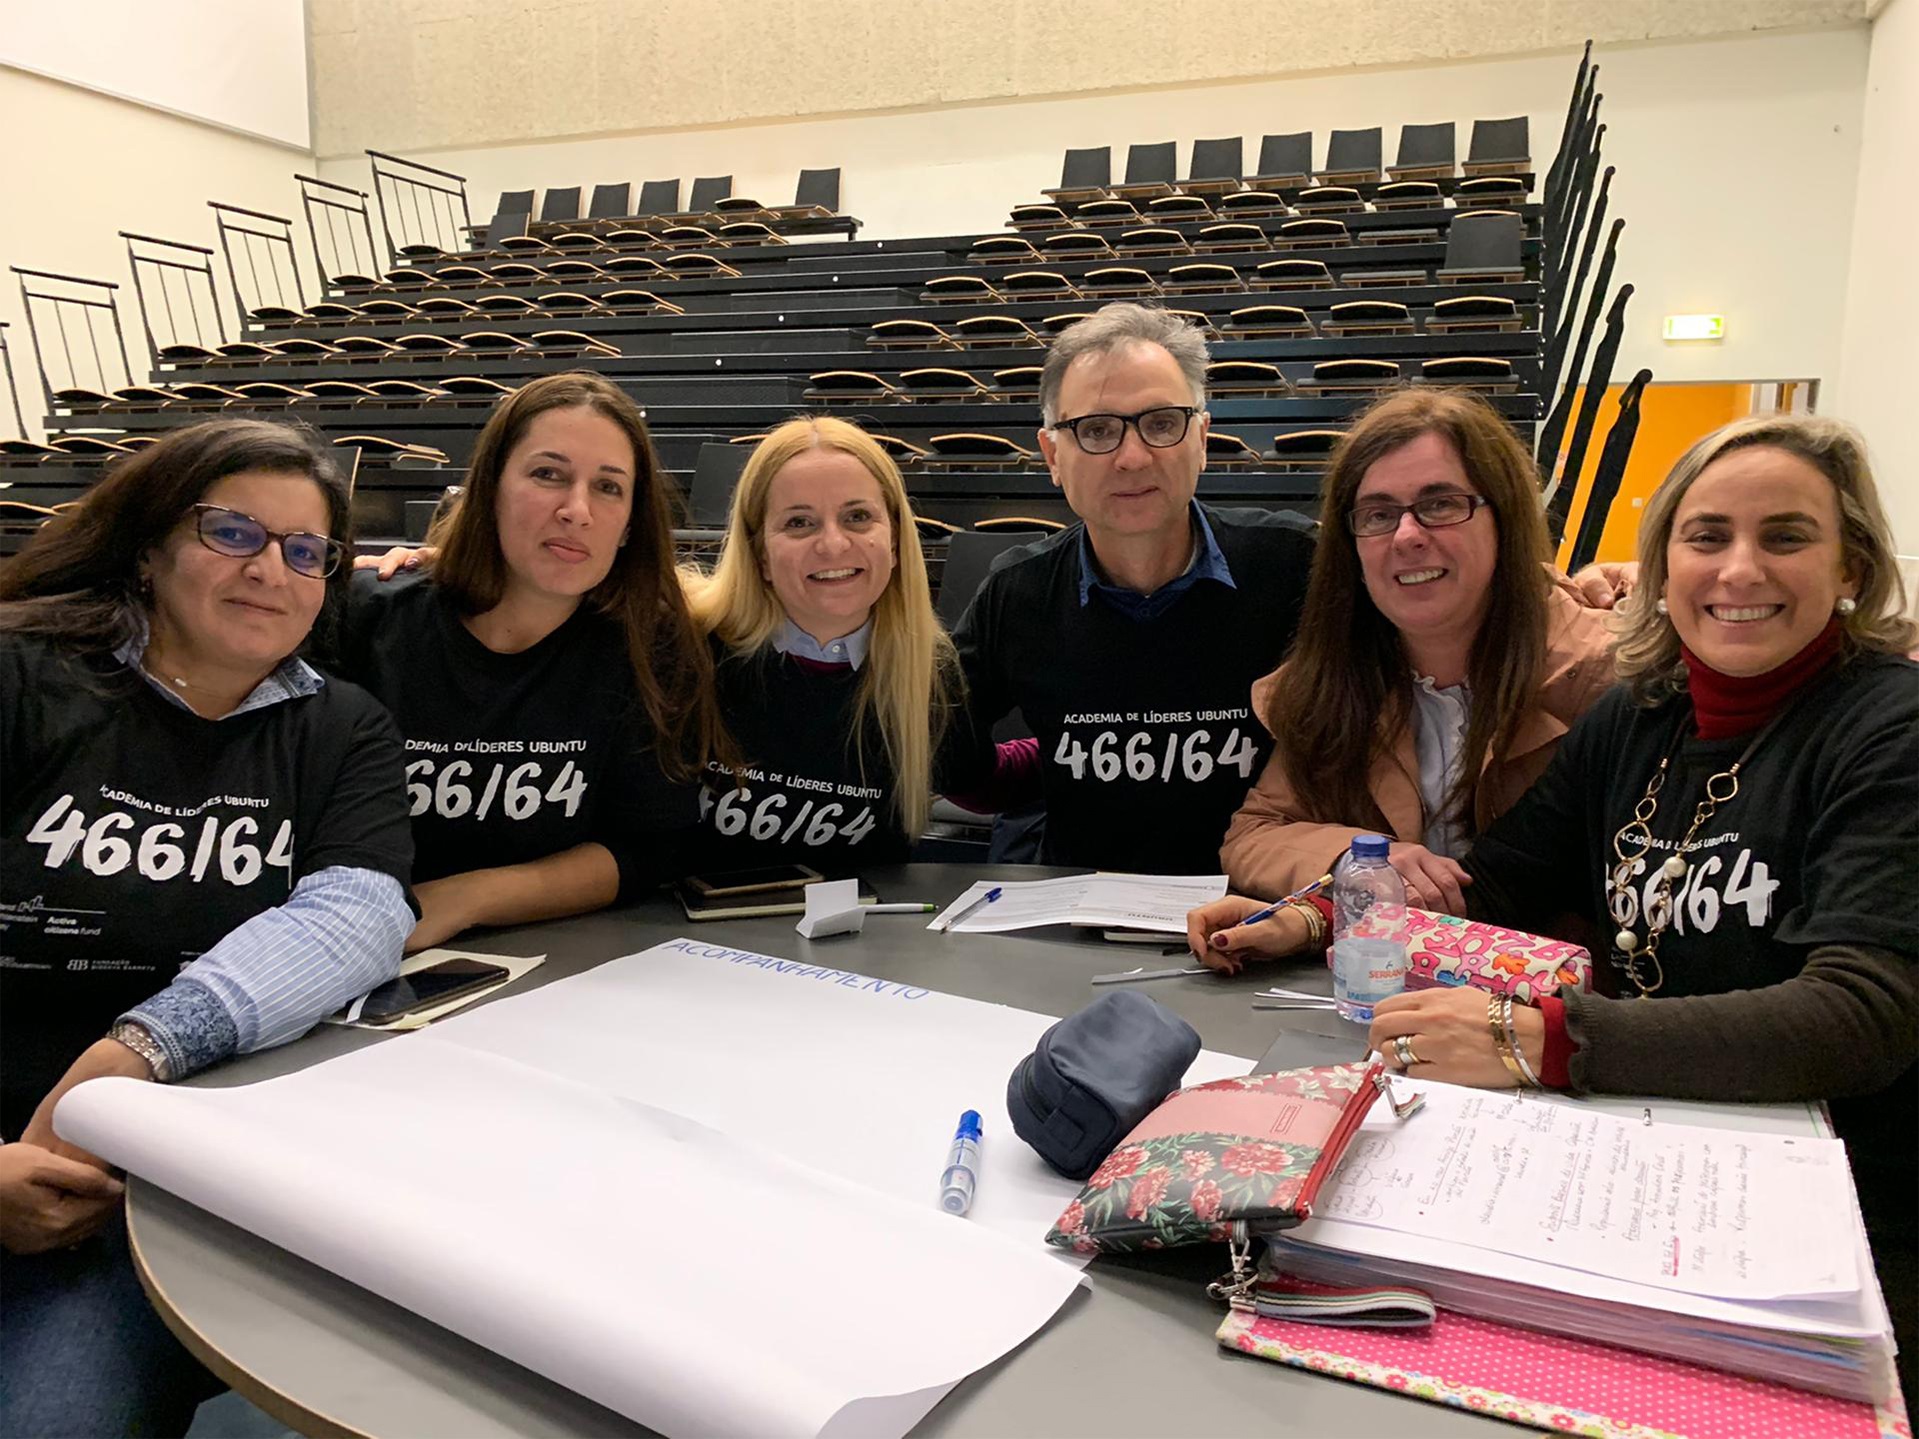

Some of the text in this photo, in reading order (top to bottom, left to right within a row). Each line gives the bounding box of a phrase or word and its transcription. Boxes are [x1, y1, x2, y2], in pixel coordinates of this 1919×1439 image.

[1063, 708, 1248, 724] ACADEMIA DE LÍDERES UBUNTU
[405, 739, 449, 753] DEMIA
[468, 738, 524, 754] LÍDERES
[529, 740, 587, 753] UBUNTU
[1054, 728, 1259, 783] 466/64
[405, 759, 588, 821] 66/64
[705, 760, 882, 799] CADEMIA DE LÍDERES UBUNTU
[154, 804, 172, 815] DE
[668, 940, 930, 1000] ACOMPANHAMENTO
